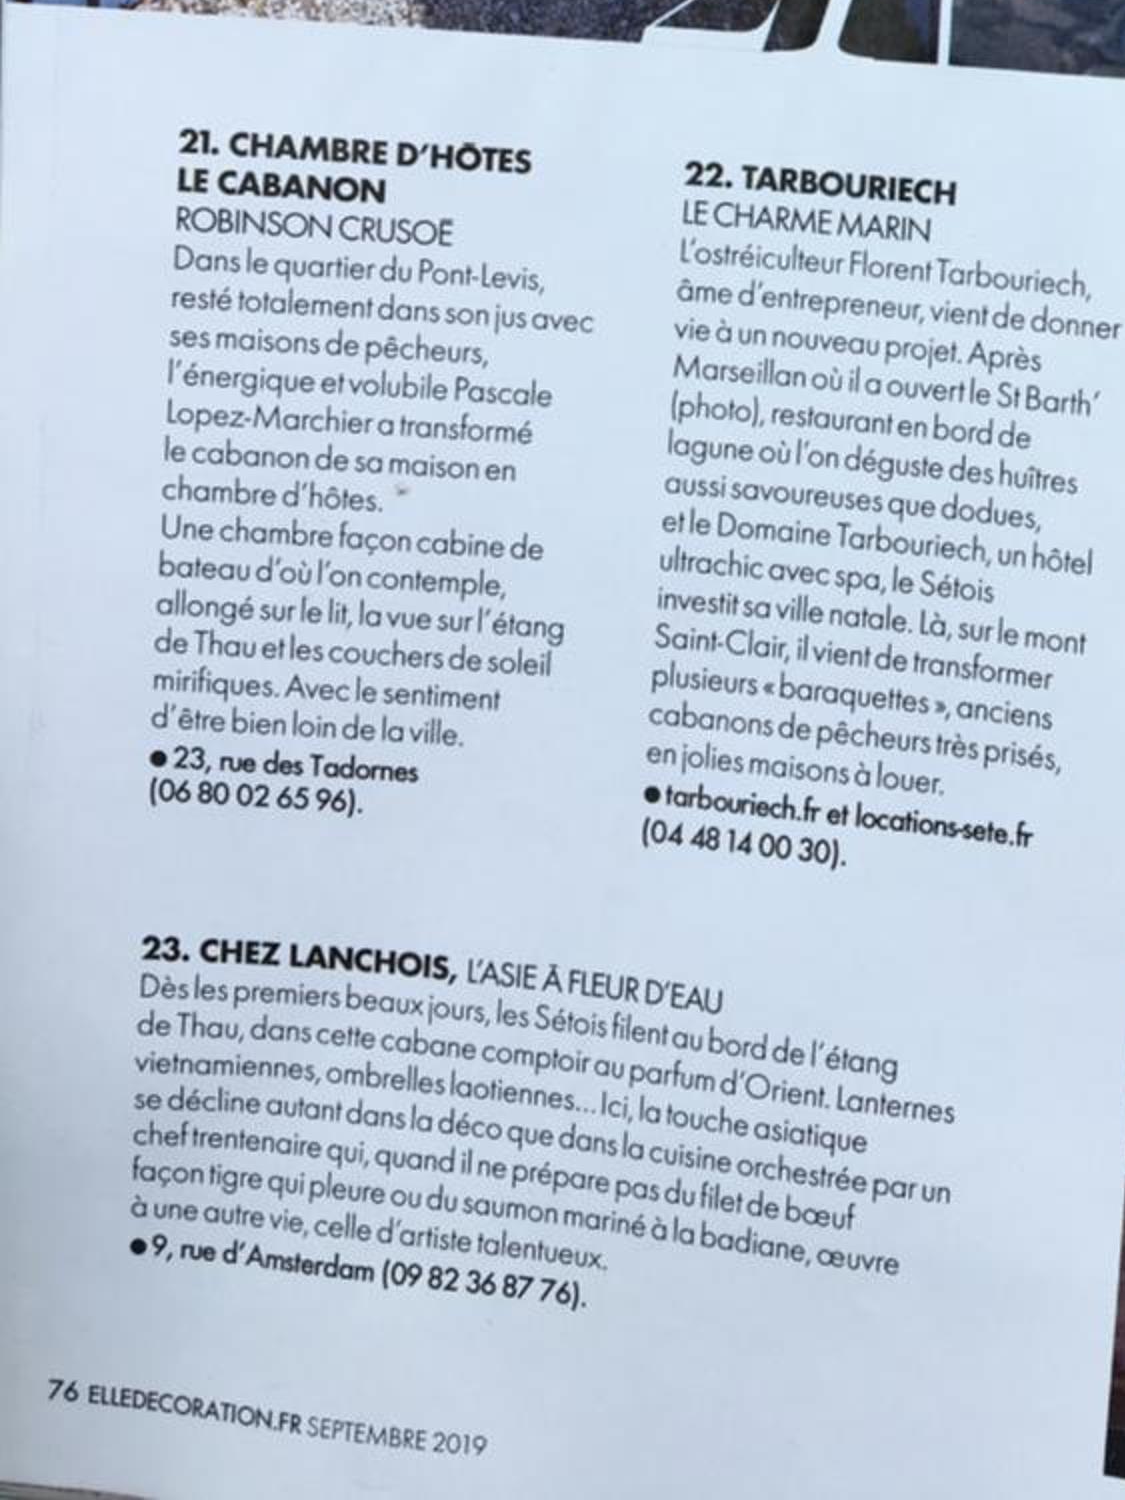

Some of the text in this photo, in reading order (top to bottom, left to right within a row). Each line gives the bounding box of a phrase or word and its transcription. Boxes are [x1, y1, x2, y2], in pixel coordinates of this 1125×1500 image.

[179, 128, 533, 175] 21. CHAMBRE D'HÔTES
[177, 166, 387, 205] LE CABANON
[684, 160, 958, 207] 22. TARBOURIECH
[177, 206, 334, 240] ROBINSON
[683, 199, 932, 244] LE CHARME MARIN
[174, 245, 544, 297] Dans le quartier du Pont-Levis,
[172, 287, 595, 335] resté totalement dans son jus avec
[677, 278, 1123, 340] âme d'entrepreneur, vient de donner
[675, 318, 1042, 375] vie à un nouveau projet. Après
[167, 398, 534, 446] Lopez-Marchier a transformé
[672, 389, 1032, 450] (photo), restaurant en bord de
[162, 474, 383, 513] chambre d'hôtes.
[665, 466, 1042, 535] aussi savoureuses que dodues,
[162, 513, 544, 561] Une chambre façon cabine de
[660, 545, 995, 604] ultrachic avec spa, le Sétois
[155, 626, 552, 677] de Thau et les couchers de soleil
[153, 666, 501, 712] mirifiques. Avec le sentiment
[173, 745, 420, 784] 23, rue des Tadornes
[649, 700, 1061, 776] cabanons de pêcheurs très prisés,
[150, 776, 363, 819] (06 80 02 65 96).
[666, 783, 1035, 848] tarbouriech.fr et locations-sete.fr
[642, 816, 847, 872] (04 48 14 00 30).
[141, 935, 191, 963] 23.
[199, 938, 282, 968] CHEZ
[289, 943, 459, 987] LANCHOIS,
[467, 958, 539, 991] L'ASIE
[568, 969, 640, 1004] FLEUR
[645, 979, 724, 1016] D'EAU
[137, 1009, 955, 1124] de Thau, dans cette cabane comptoir au parfum d'Orient. Lanternes
[135, 1051, 322, 1087] vietnamiennes,
[326, 1060, 447, 1096] ombrelles
[601, 1091, 634, 1125] Ici,
[639, 1094, 662, 1125] la
[666, 1103, 749, 1138] touche
[754, 1119, 868, 1158] asiatique
[134, 1120, 856, 1231] chef trentenaire qui, quand il ne prépare pas du filet de bœuf
[131, 1194, 608, 1271] à une autre vie, celle d'artiste talentueux.
[151, 1233, 587, 1312] 9, rue d'Amsterdam (09 82 36 87 76).
[47, 1378, 488, 1456] 76 ELLEDECORATION.FR SEPTEMBRE 2019
